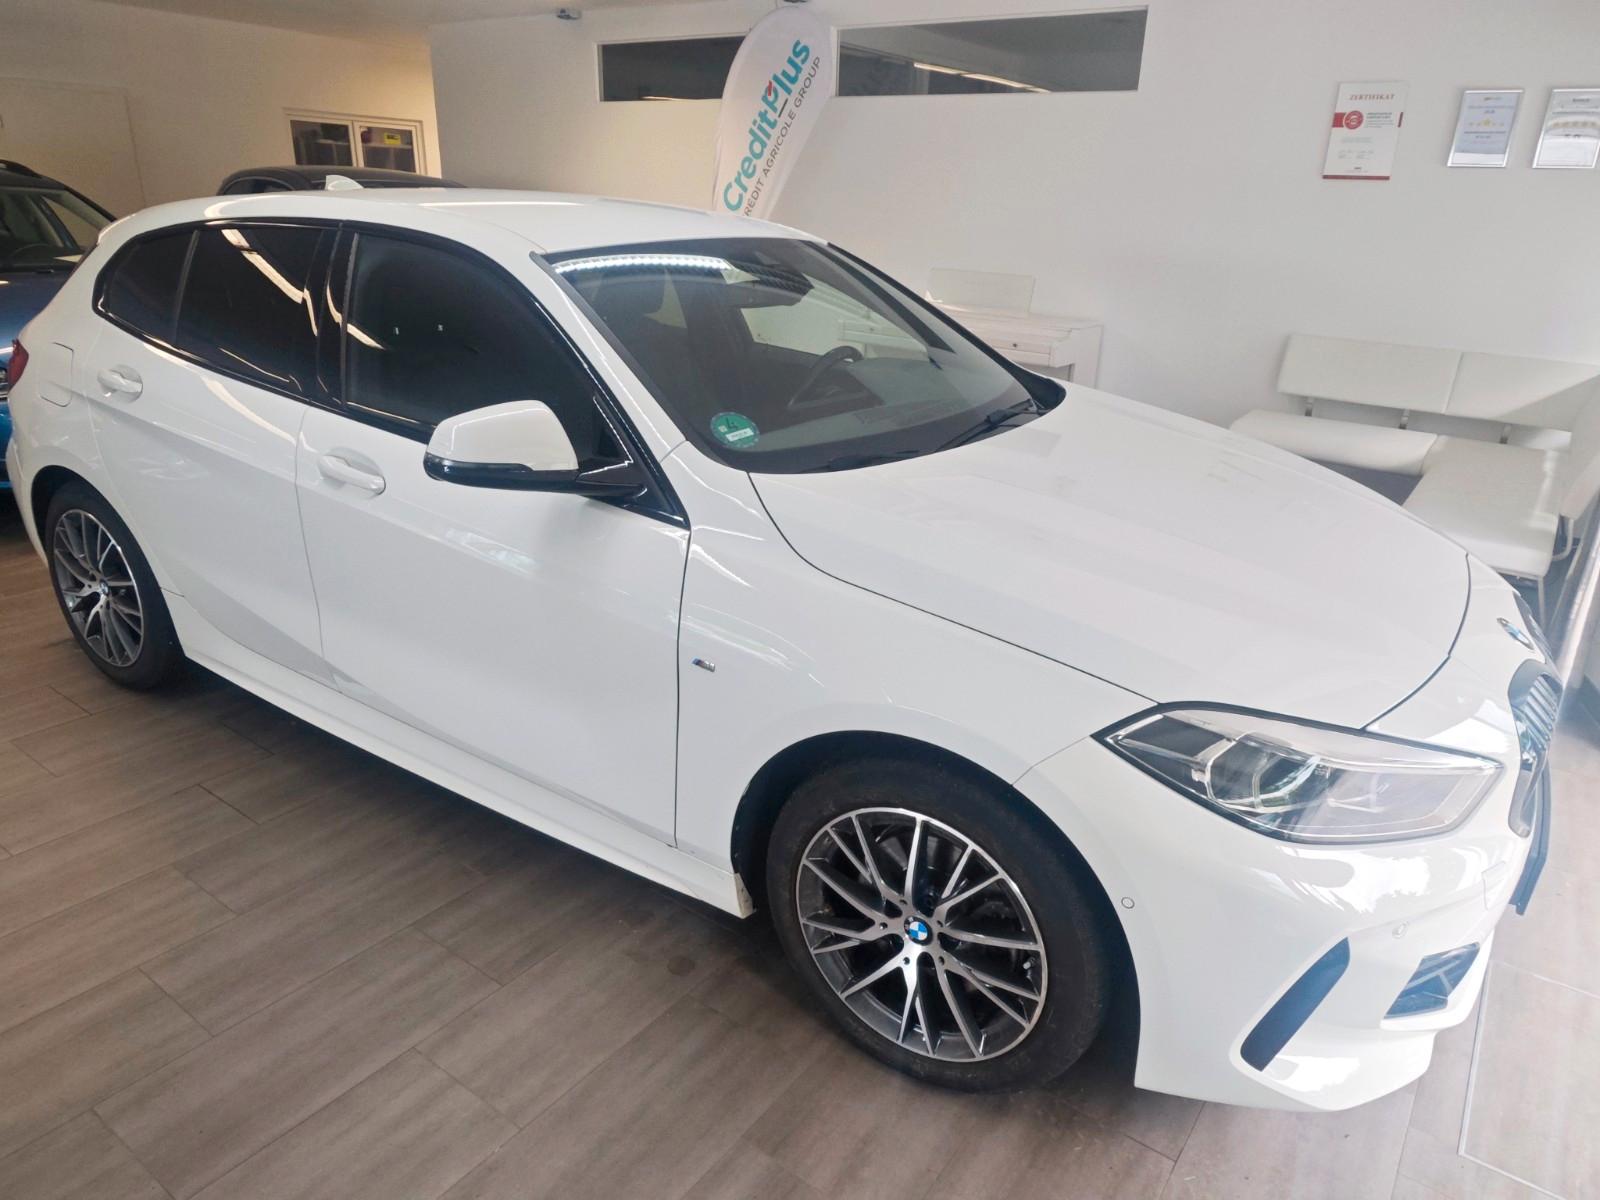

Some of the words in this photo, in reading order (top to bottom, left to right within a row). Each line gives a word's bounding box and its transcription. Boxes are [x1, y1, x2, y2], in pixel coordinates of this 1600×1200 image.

[723, 39, 810, 212] CreditPlus
[742, 178, 764, 217] REDIT
[762, 110, 797, 177] AGRICOLE
[794, 56, 821, 108] GROUP
